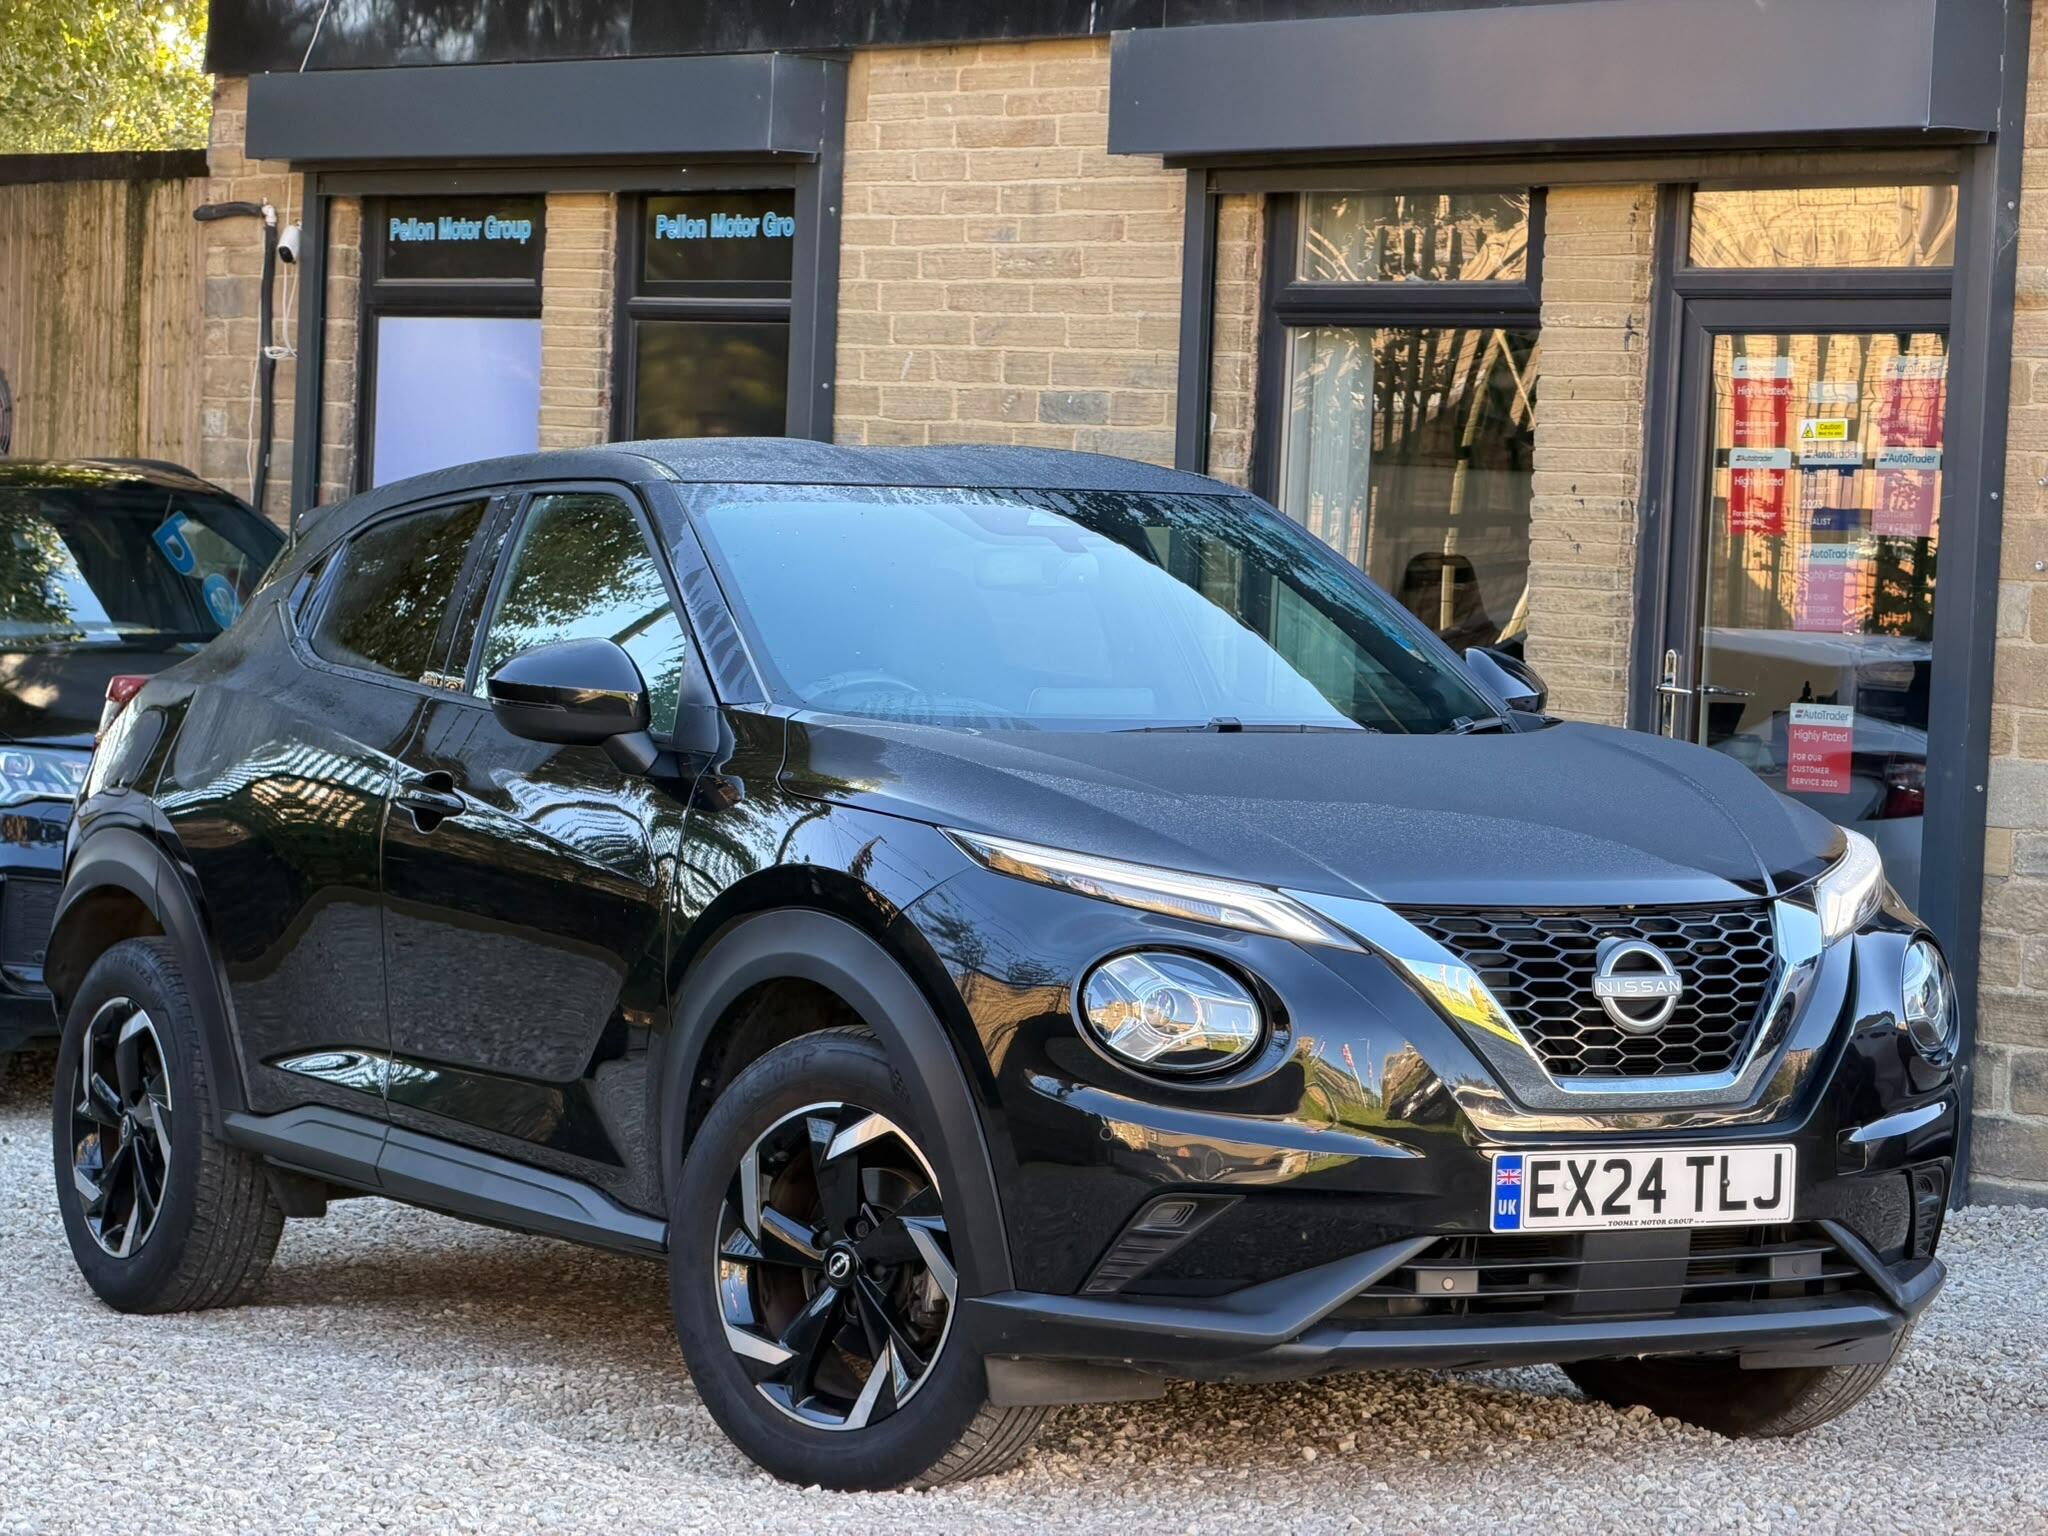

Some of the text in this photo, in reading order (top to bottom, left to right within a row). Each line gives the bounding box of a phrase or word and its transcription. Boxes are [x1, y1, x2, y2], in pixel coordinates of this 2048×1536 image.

[390, 215, 531, 244] Pellon Motor Group
[655, 211, 795, 239] Pellon Motor Gro
[1819, 423, 1841, 431] Caution
[1888, 453, 1936, 464] AutoTrader
[1804, 710, 1849, 721] AutoTrader
[1794, 729, 1848, 742] Highly Rated
[1792, 753, 1823, 762] FOR OUR
[1792, 765, 1830, 774] CUSTOMER
[1792, 777, 1839, 788] SERVICE 2020
[1598, 980, 1681, 993] NISSAN
[1529, 1153, 1783, 1218] EX24 TLJ
[1497, 1199, 1517, 1216] UK
[1640, 1218, 1667, 1226] MOTOR
[1668, 1217, 1694, 1225] GROUP
